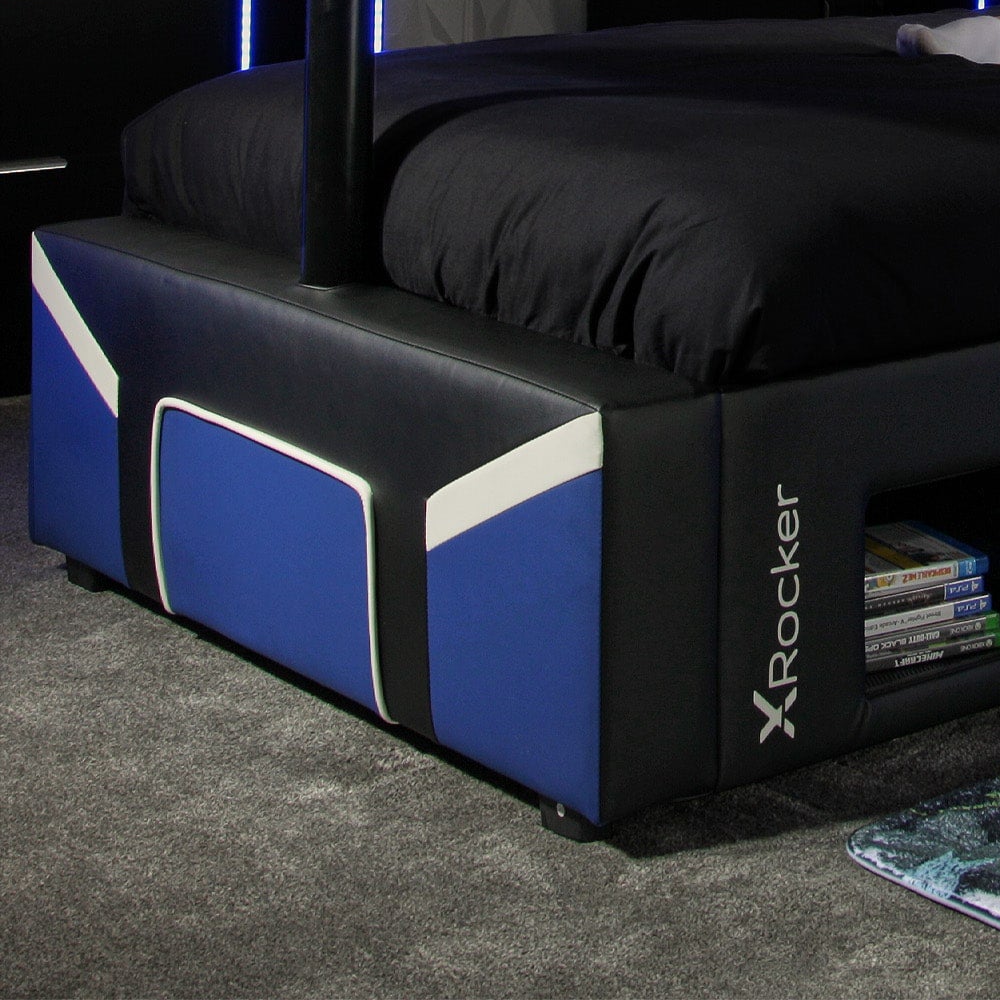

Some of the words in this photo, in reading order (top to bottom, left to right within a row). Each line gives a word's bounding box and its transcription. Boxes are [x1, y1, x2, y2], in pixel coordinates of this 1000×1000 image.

[949, 584, 968, 593] PS4
[957, 603, 977, 612] PS4
[881, 638, 907, 649] BLACK
[894, 650, 944, 667] MINECRAFT
